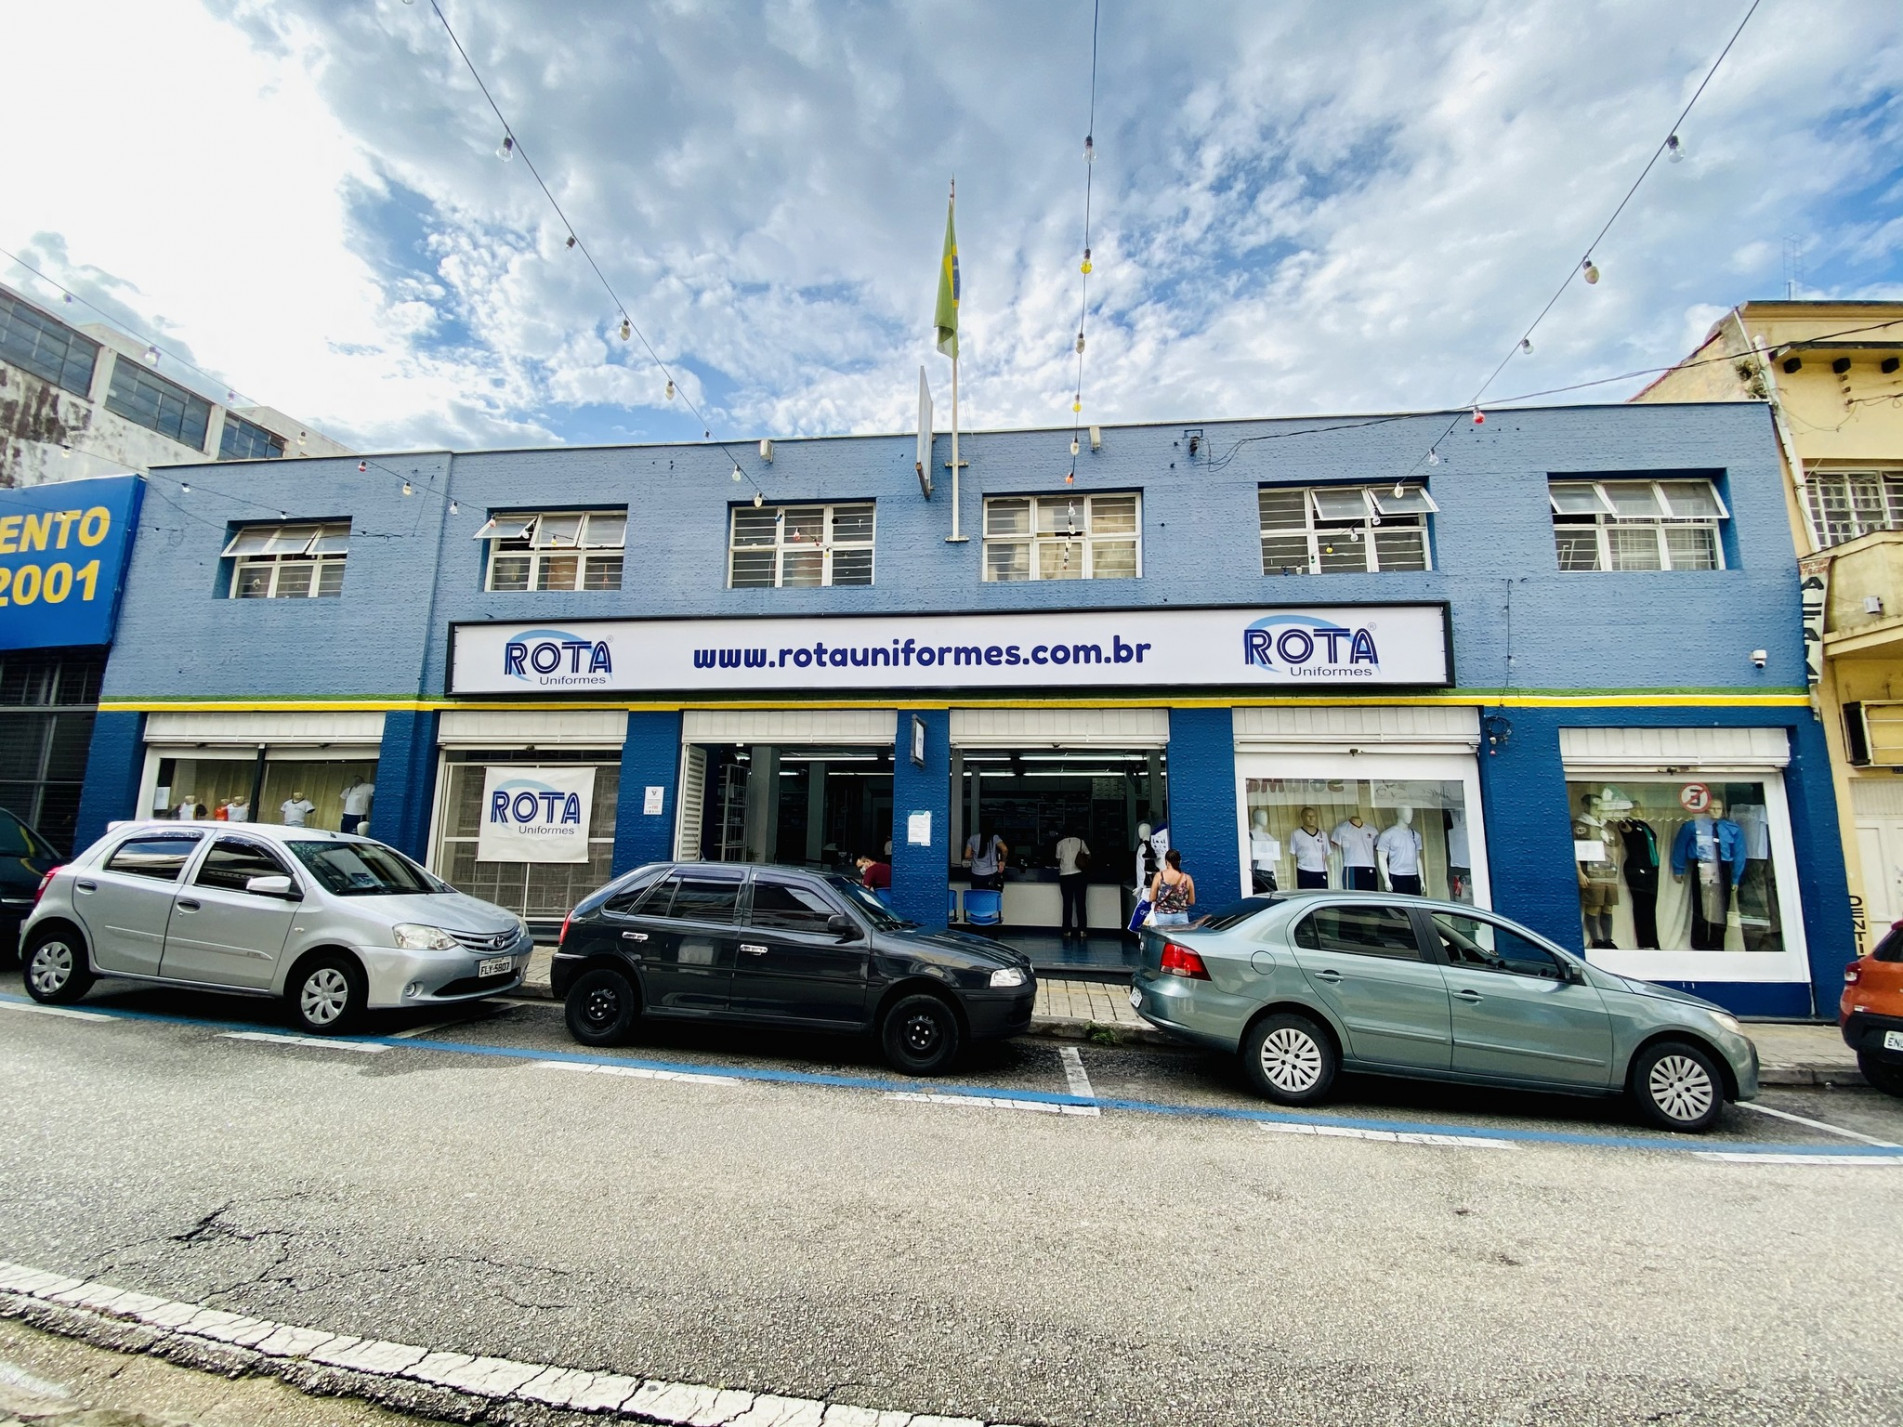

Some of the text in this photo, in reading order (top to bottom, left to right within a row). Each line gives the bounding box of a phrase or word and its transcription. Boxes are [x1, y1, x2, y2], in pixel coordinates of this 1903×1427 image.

[0, 505, 111, 554] ENTO
[0, 559, 101, 607] 2001
[504, 640, 613, 676] ROTA
[693, 635, 1152, 669] www.rotauniformes.com.br
[1244, 628, 1379, 665] ROTA
[539, 675, 607, 686] Uniformes
[1290, 666, 1373, 677] Uniformes
[490, 790, 581, 825] ROTA
[518, 825, 575, 835] Uniformes
[1849, 894, 1868, 958] DENTI
